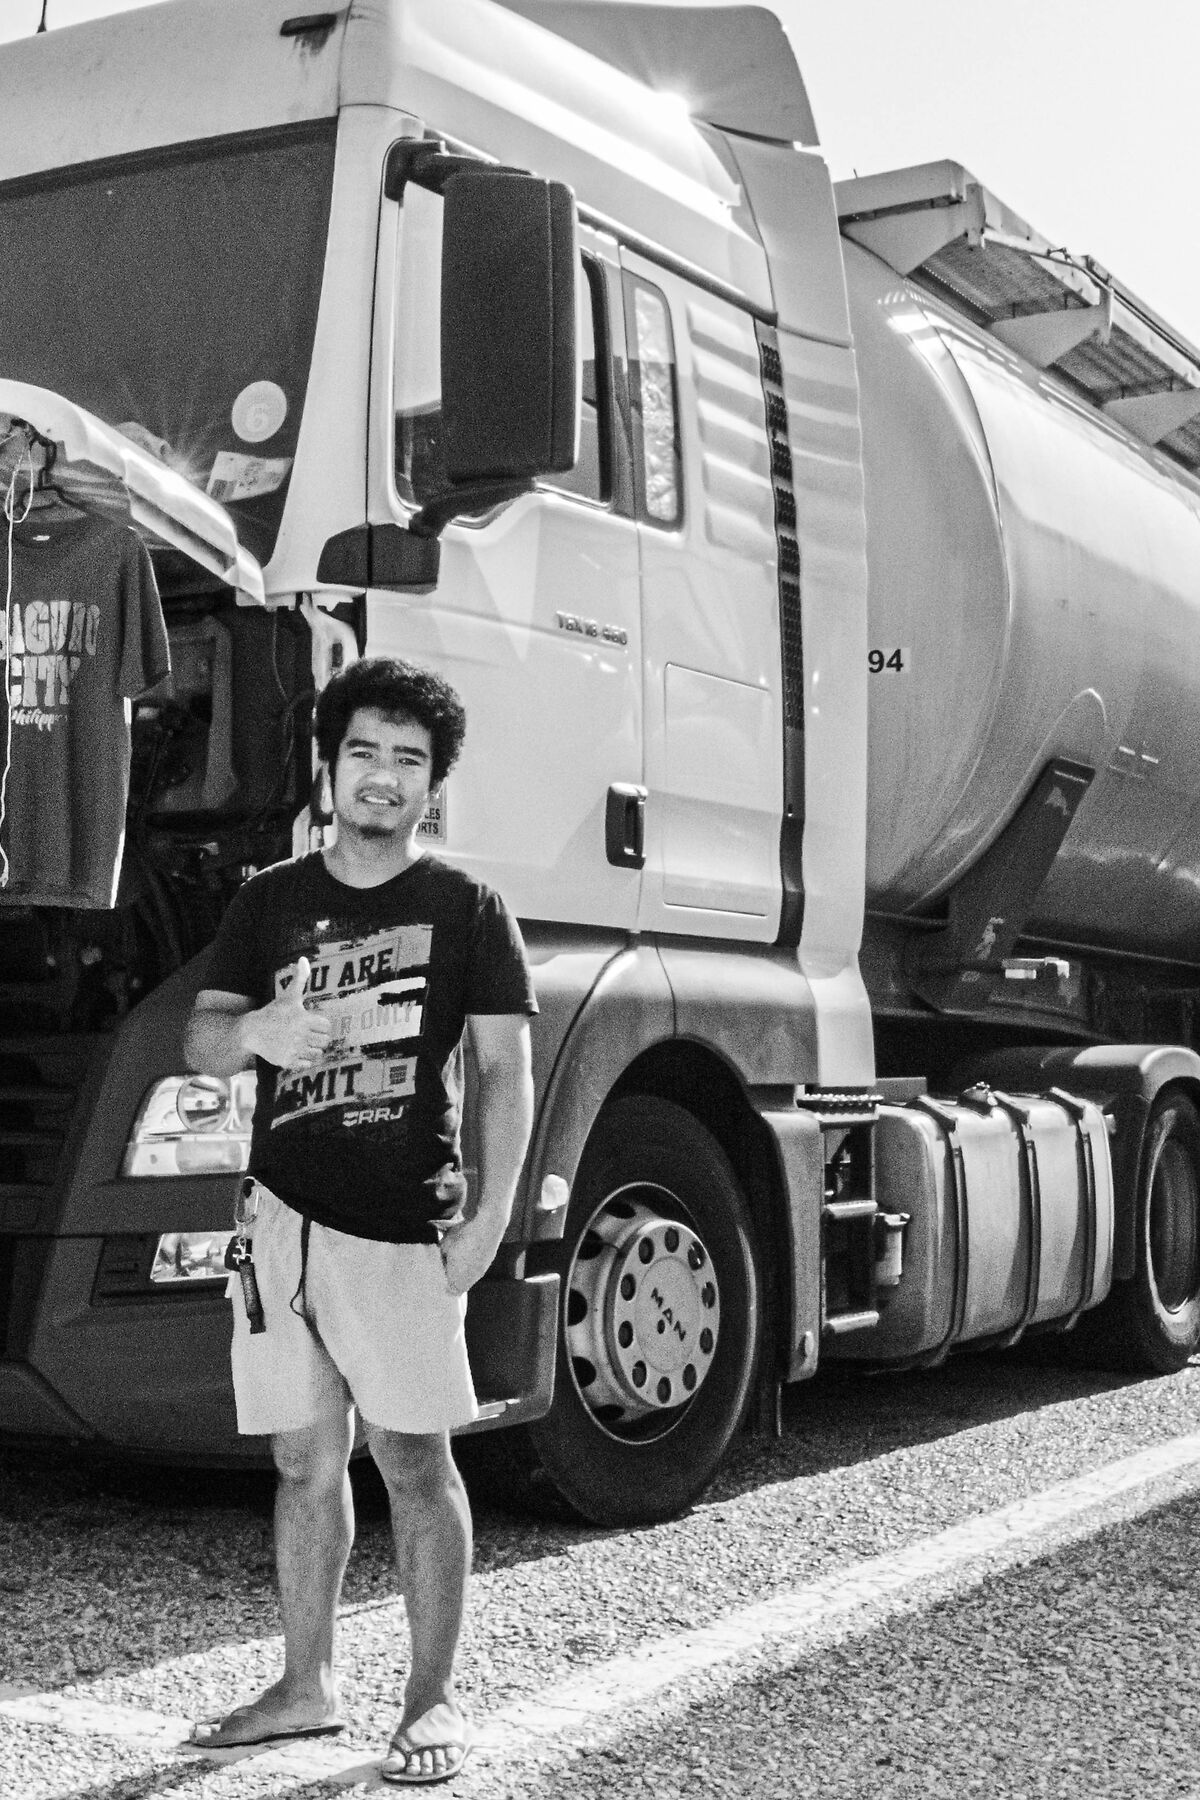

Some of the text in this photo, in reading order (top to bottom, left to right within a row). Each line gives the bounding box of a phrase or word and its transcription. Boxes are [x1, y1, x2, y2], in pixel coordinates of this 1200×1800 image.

[338, 948, 394, 988] ARE
[361, 1000, 417, 1030] ONLY
[651, 1287, 686, 1342] MAN
